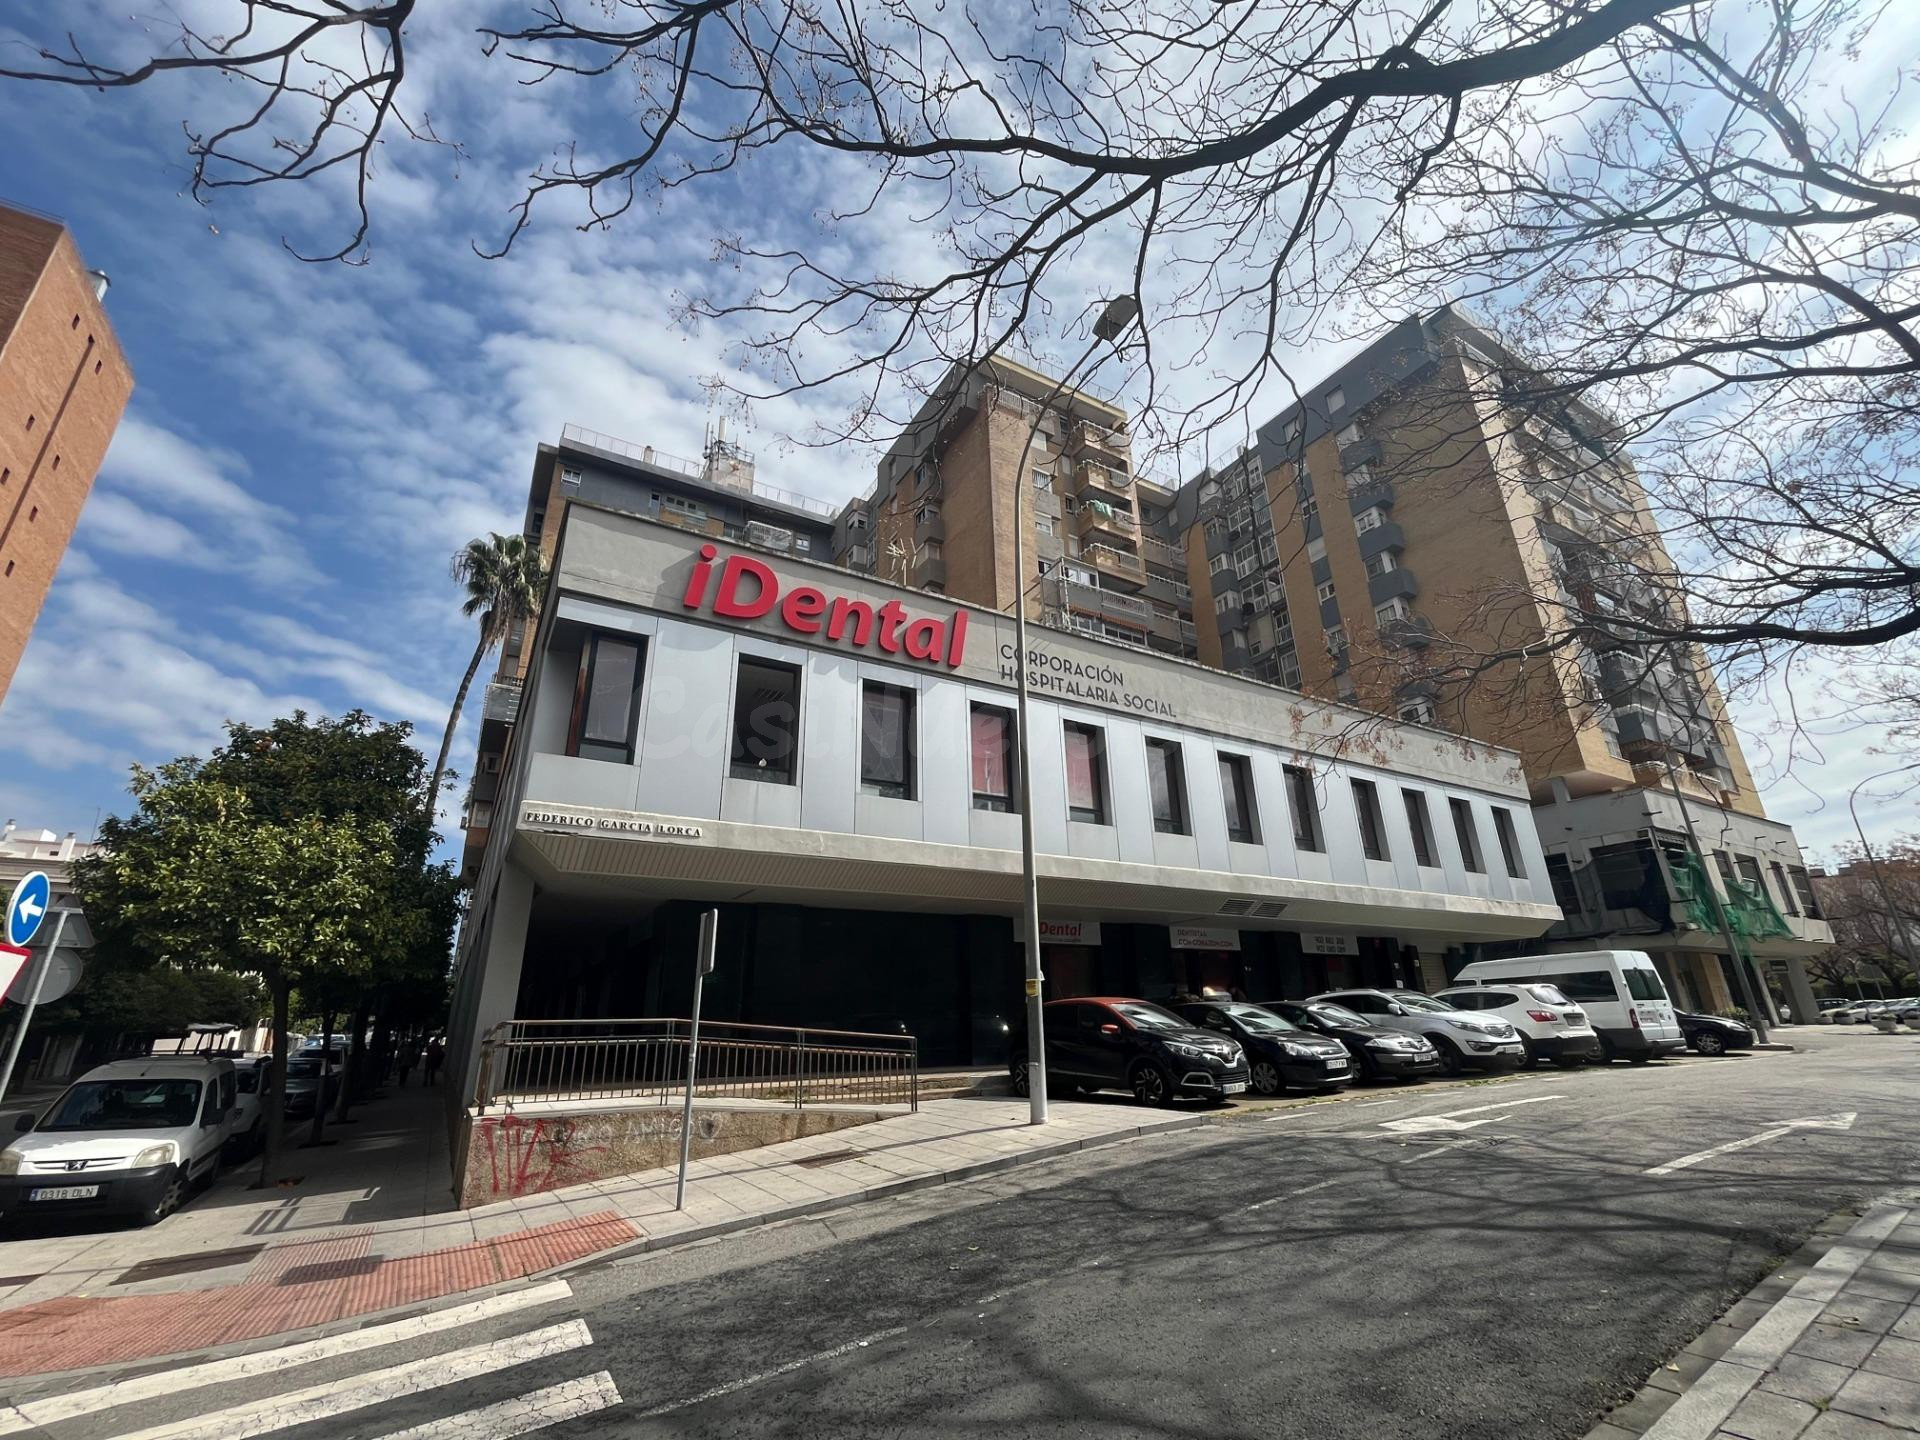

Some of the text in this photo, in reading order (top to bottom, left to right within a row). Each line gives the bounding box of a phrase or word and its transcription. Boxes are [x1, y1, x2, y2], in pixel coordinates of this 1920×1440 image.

[683, 543, 969, 668] iDental
[1123, 692, 1177, 718] SOCIAL
[526, 812, 701, 837] FEDERICO GARCIA LORCA
[1039, 921, 1082, 936] Dental
